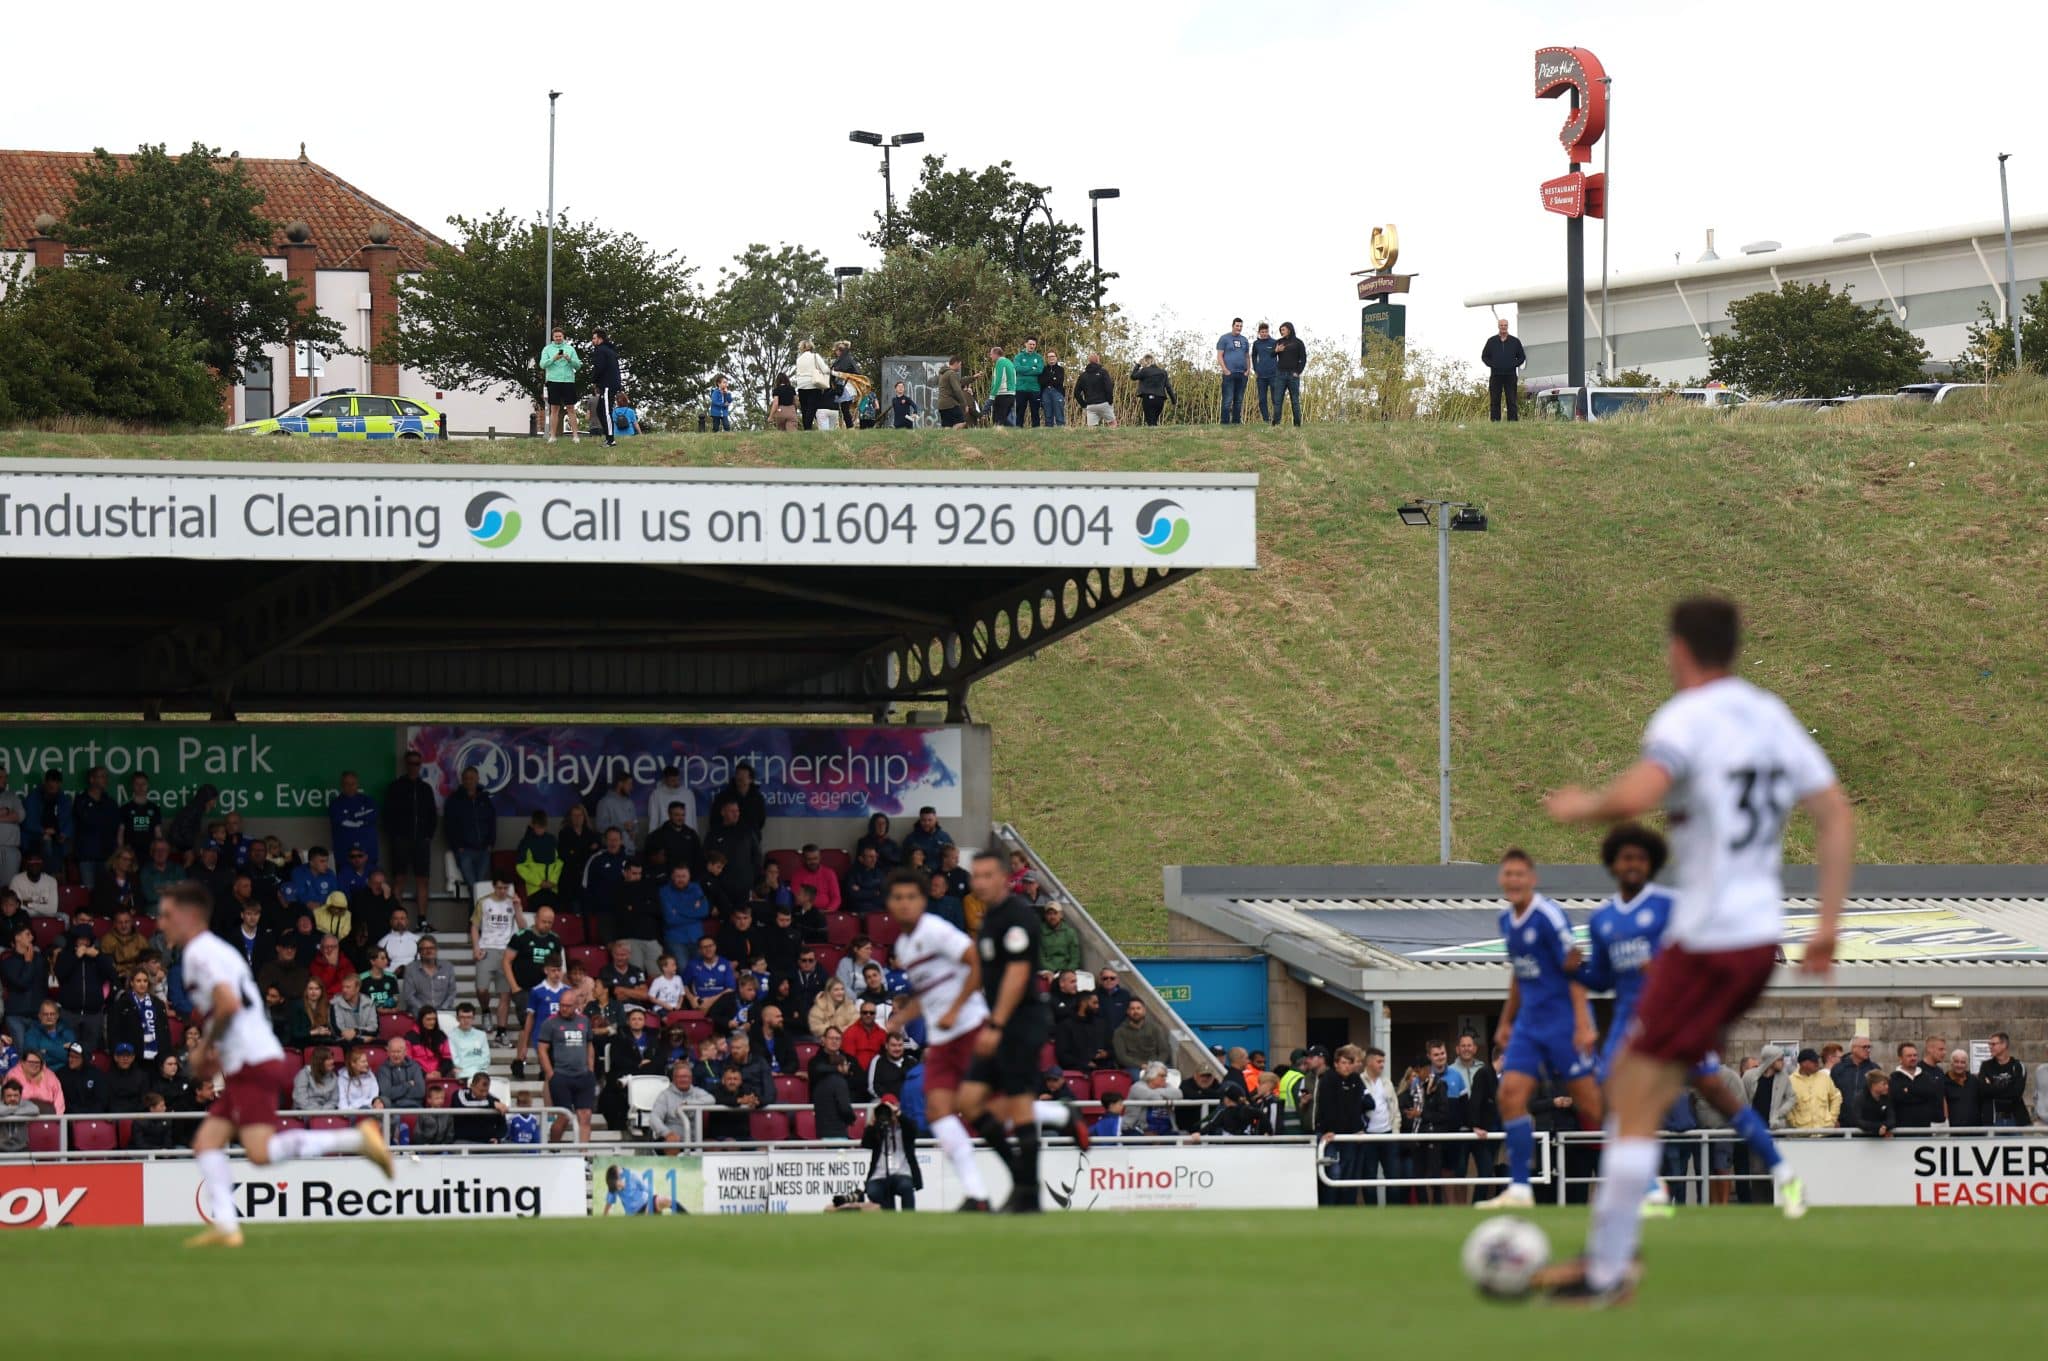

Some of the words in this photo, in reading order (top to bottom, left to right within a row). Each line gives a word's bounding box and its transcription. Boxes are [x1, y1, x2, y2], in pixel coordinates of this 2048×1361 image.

[1538, 63, 1559, 79] Pizza
[1559, 61, 1575, 76] Hut
[1545, 185, 1577, 195] RESTAURANT
[0, 493, 217, 539] Industrial
[243, 493, 440, 548] Cleaning
[541, 498, 621, 542] Call
[641, 508, 690, 542] us
[708, 509, 762, 542] on
[780, 501, 918, 545] 01604
[935, 502, 1015, 545] 926
[1033, 503, 1113, 547] 004
[179, 734, 274, 774] Park
[116, 784, 249, 815] Meetigs
[276, 784, 364, 808] Even
[761, 790, 806, 806] ative
[809, 791, 870, 810] agency
[1177, 989, 1188, 1000] 12
[718, 1166, 749, 1181] WHEN
[754, 1163, 772, 1180] YOU
[777, 1162, 802, 1177] NEED
[805, 1161, 825, 1177] THE
[828, 1161, 850, 1177] NHS
[854, 1161, 865, 1176] TO
[1914, 1145, 2048, 1177] SILVER
[717, 1185, 756, 1200] TACKLE
[759, 1180, 802, 1200] ILLNESS
[806, 1180, 820, 1195] OR
[823, 1179, 860, 1194] INJURY
[1090, 1165, 1214, 1190] RhinoPro
[302, 1178, 541, 1218] Recruiting
[1915, 1182, 2048, 1207] LEASING
